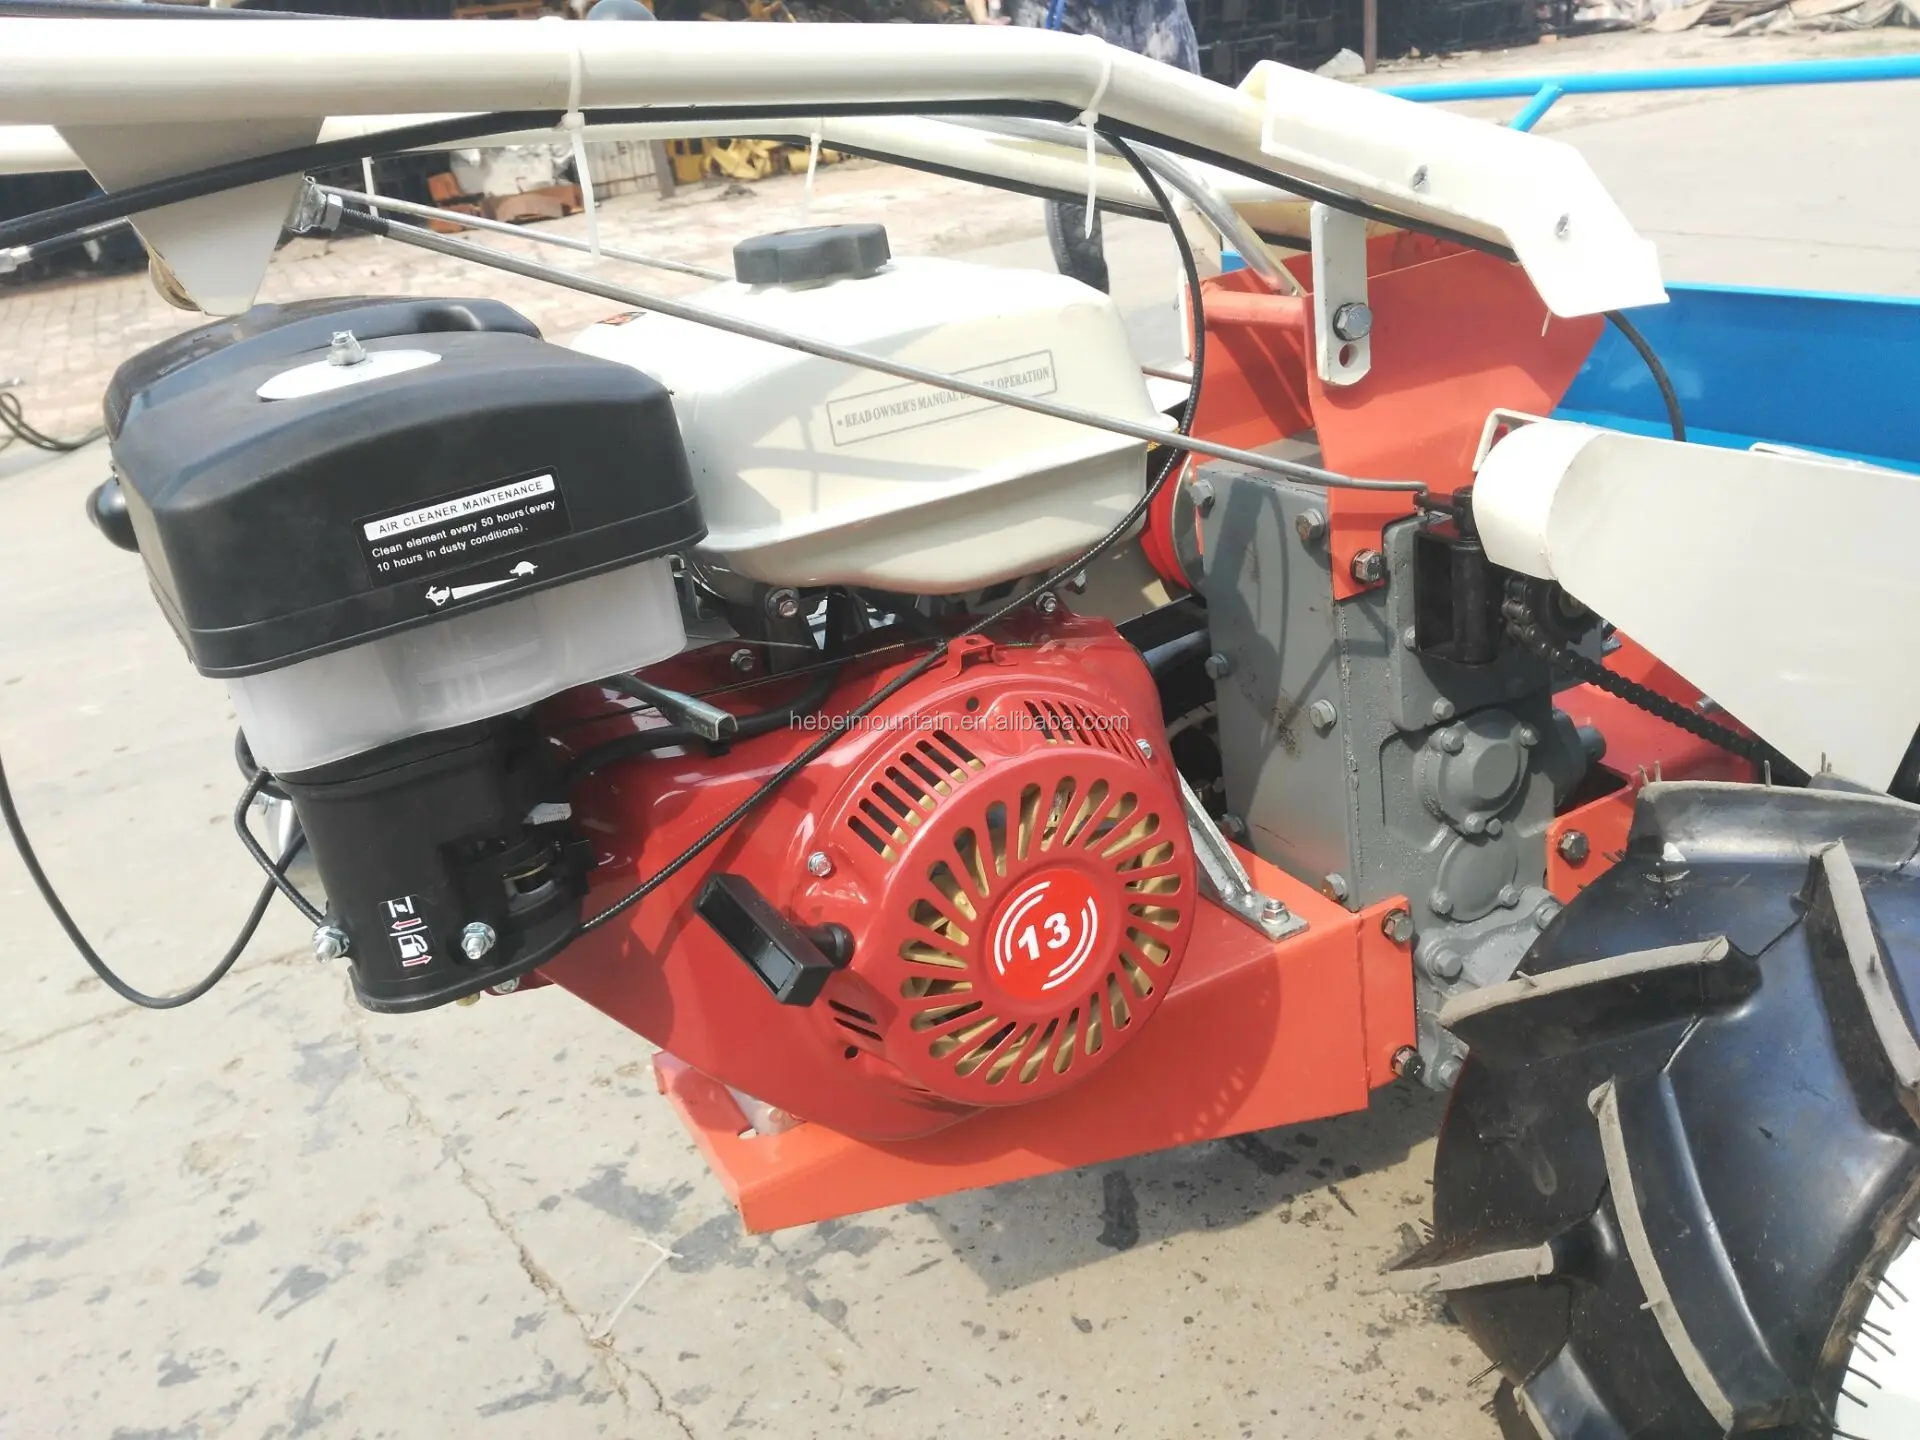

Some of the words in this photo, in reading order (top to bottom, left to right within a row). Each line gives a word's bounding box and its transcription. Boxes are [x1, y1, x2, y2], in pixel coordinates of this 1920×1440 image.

[844, 412, 872, 427] READ
[917, 390, 960, 411] MANUAL
[996, 366, 1050, 390] OPERATION
[379, 521, 398, 533] AIR
[403, 505, 458, 527] CLEANER
[463, 481, 543, 510] MAINTENANCE
[372, 542, 402, 558] Clean
[406, 530, 447, 547] element
[450, 524, 478, 538] every
[481, 517, 494, 527] 50
[377, 561, 390, 572] 10
[393, 554, 423, 567] hours
[426, 550, 437, 558] in
[439, 541, 466, 555] dusty
[1018, 912, 1070, 960] 13
